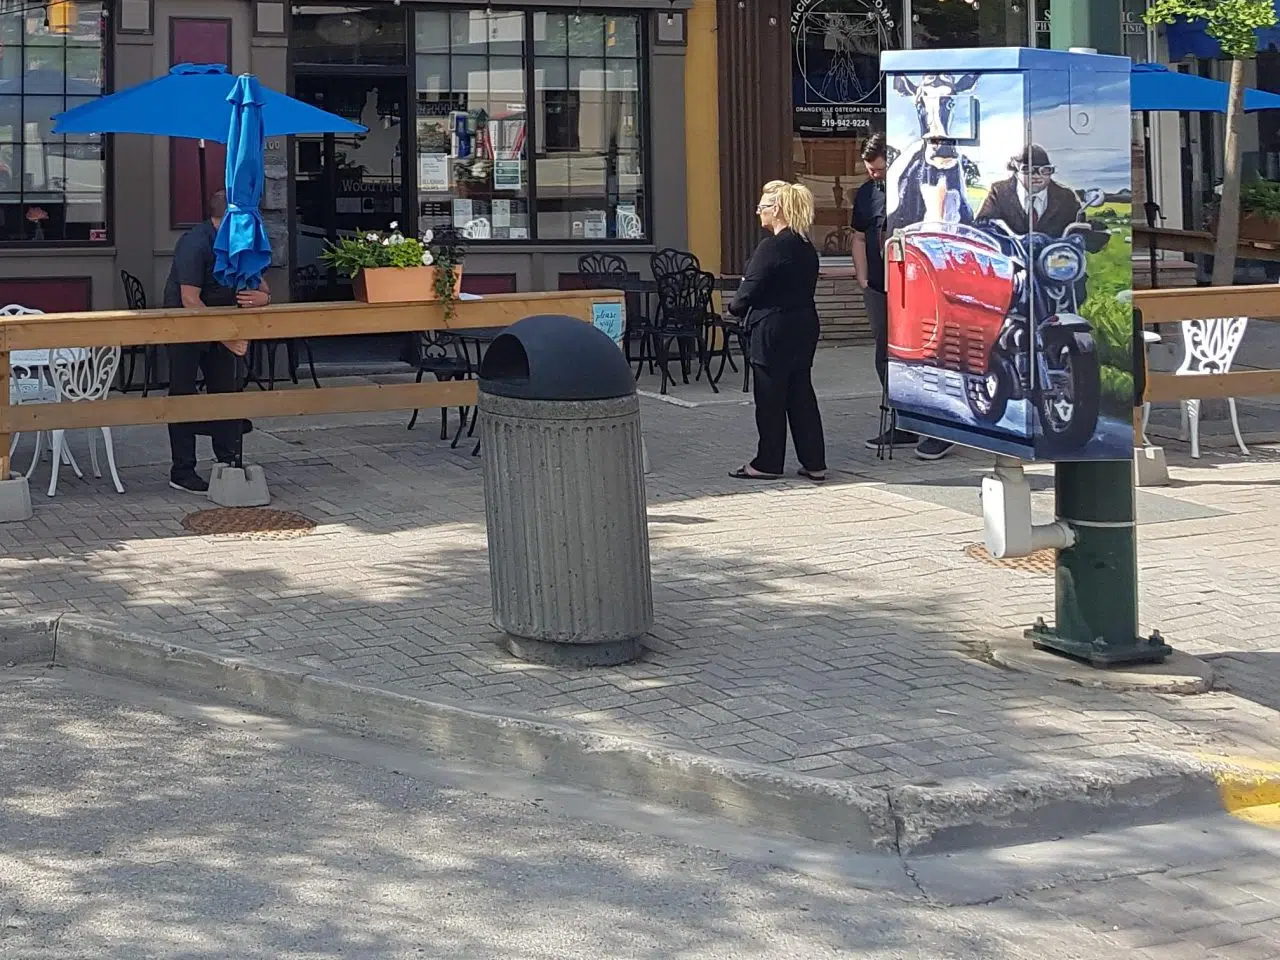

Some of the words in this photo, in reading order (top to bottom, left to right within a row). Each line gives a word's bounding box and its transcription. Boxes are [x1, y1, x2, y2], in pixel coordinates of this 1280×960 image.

[834, 106, 872, 114] OSTEOPATHIC
[873, 106, 888, 114] CLIN
[821, 119, 870, 127] 519-942-9224
